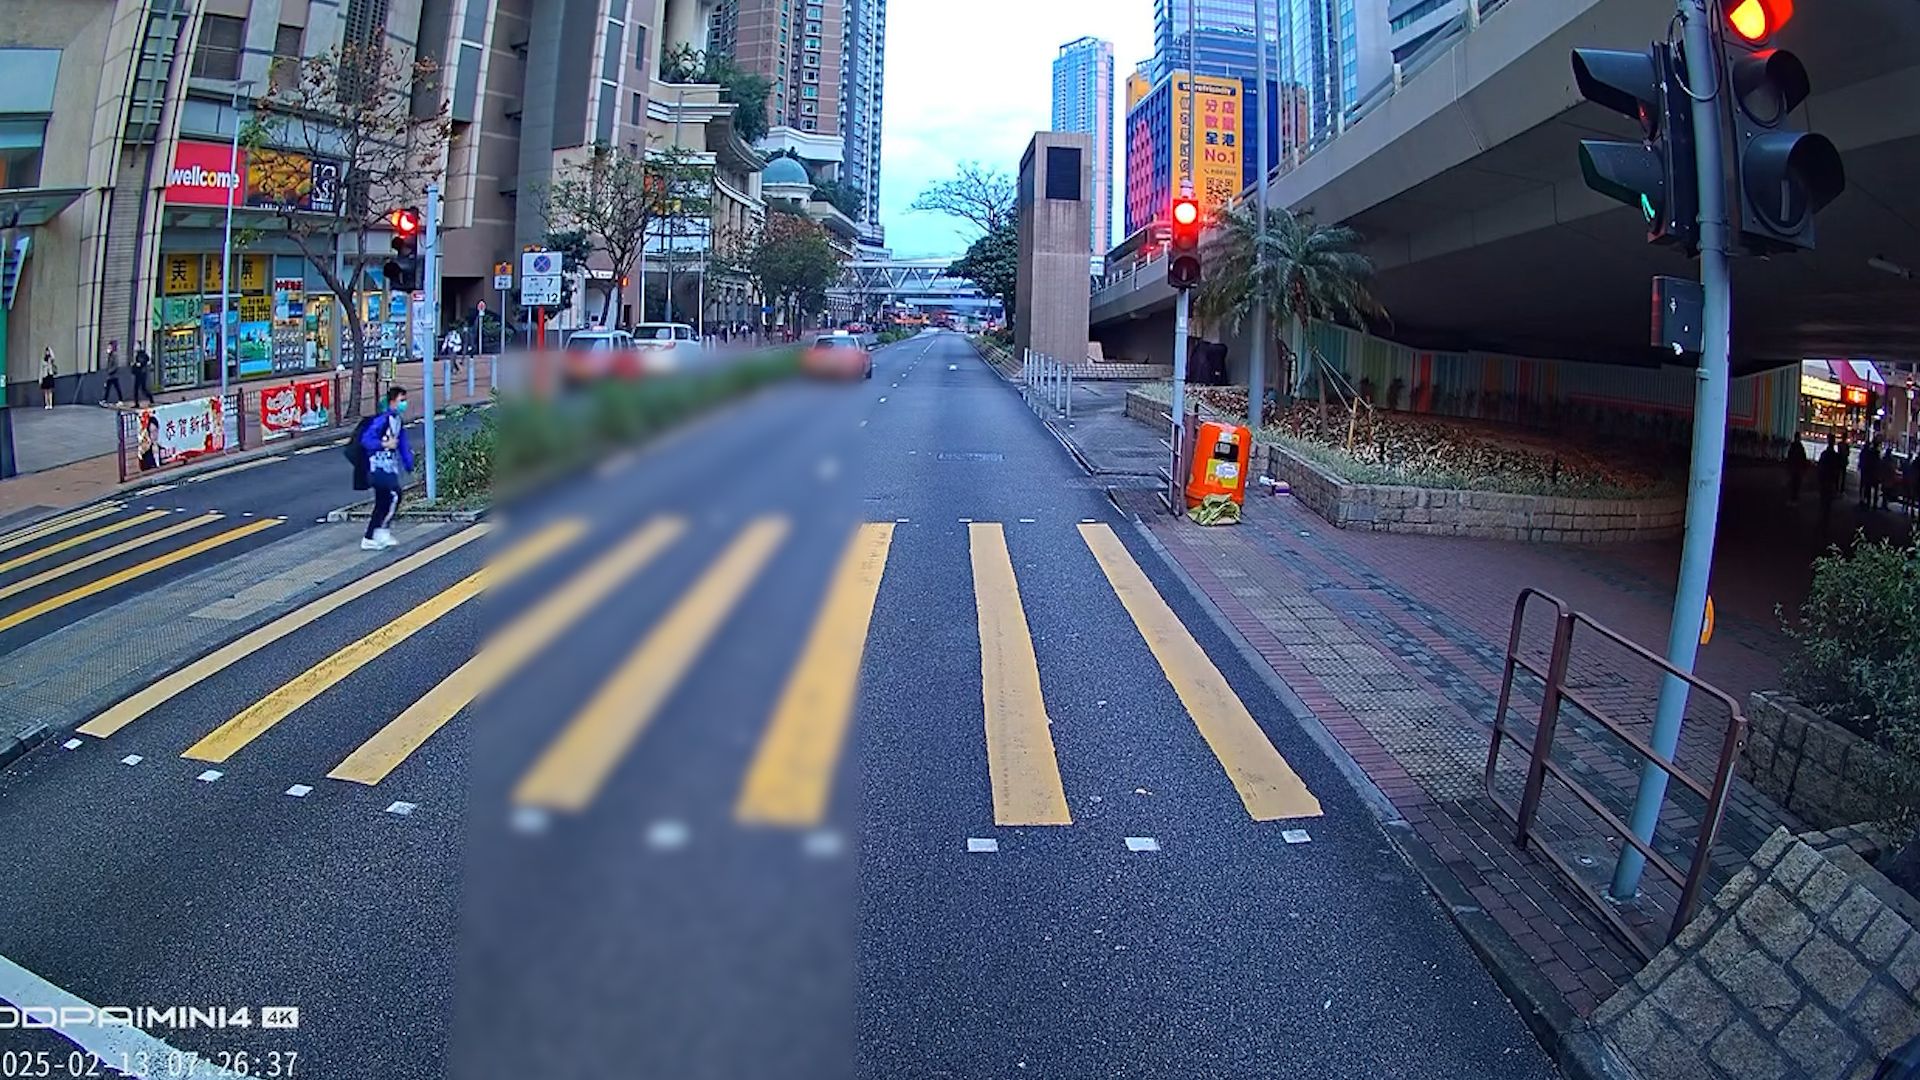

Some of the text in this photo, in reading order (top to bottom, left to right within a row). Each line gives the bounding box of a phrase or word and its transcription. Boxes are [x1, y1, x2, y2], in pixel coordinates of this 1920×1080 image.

[1182, 83, 1232, 95] strefriendly
[1205, 131, 1235, 147] 全港
[1205, 149, 1236, 165] No.1
[171, 165, 240, 189] wellcome
[547, 277, 553, 287] 7
[547, 293, 558, 303] 12
